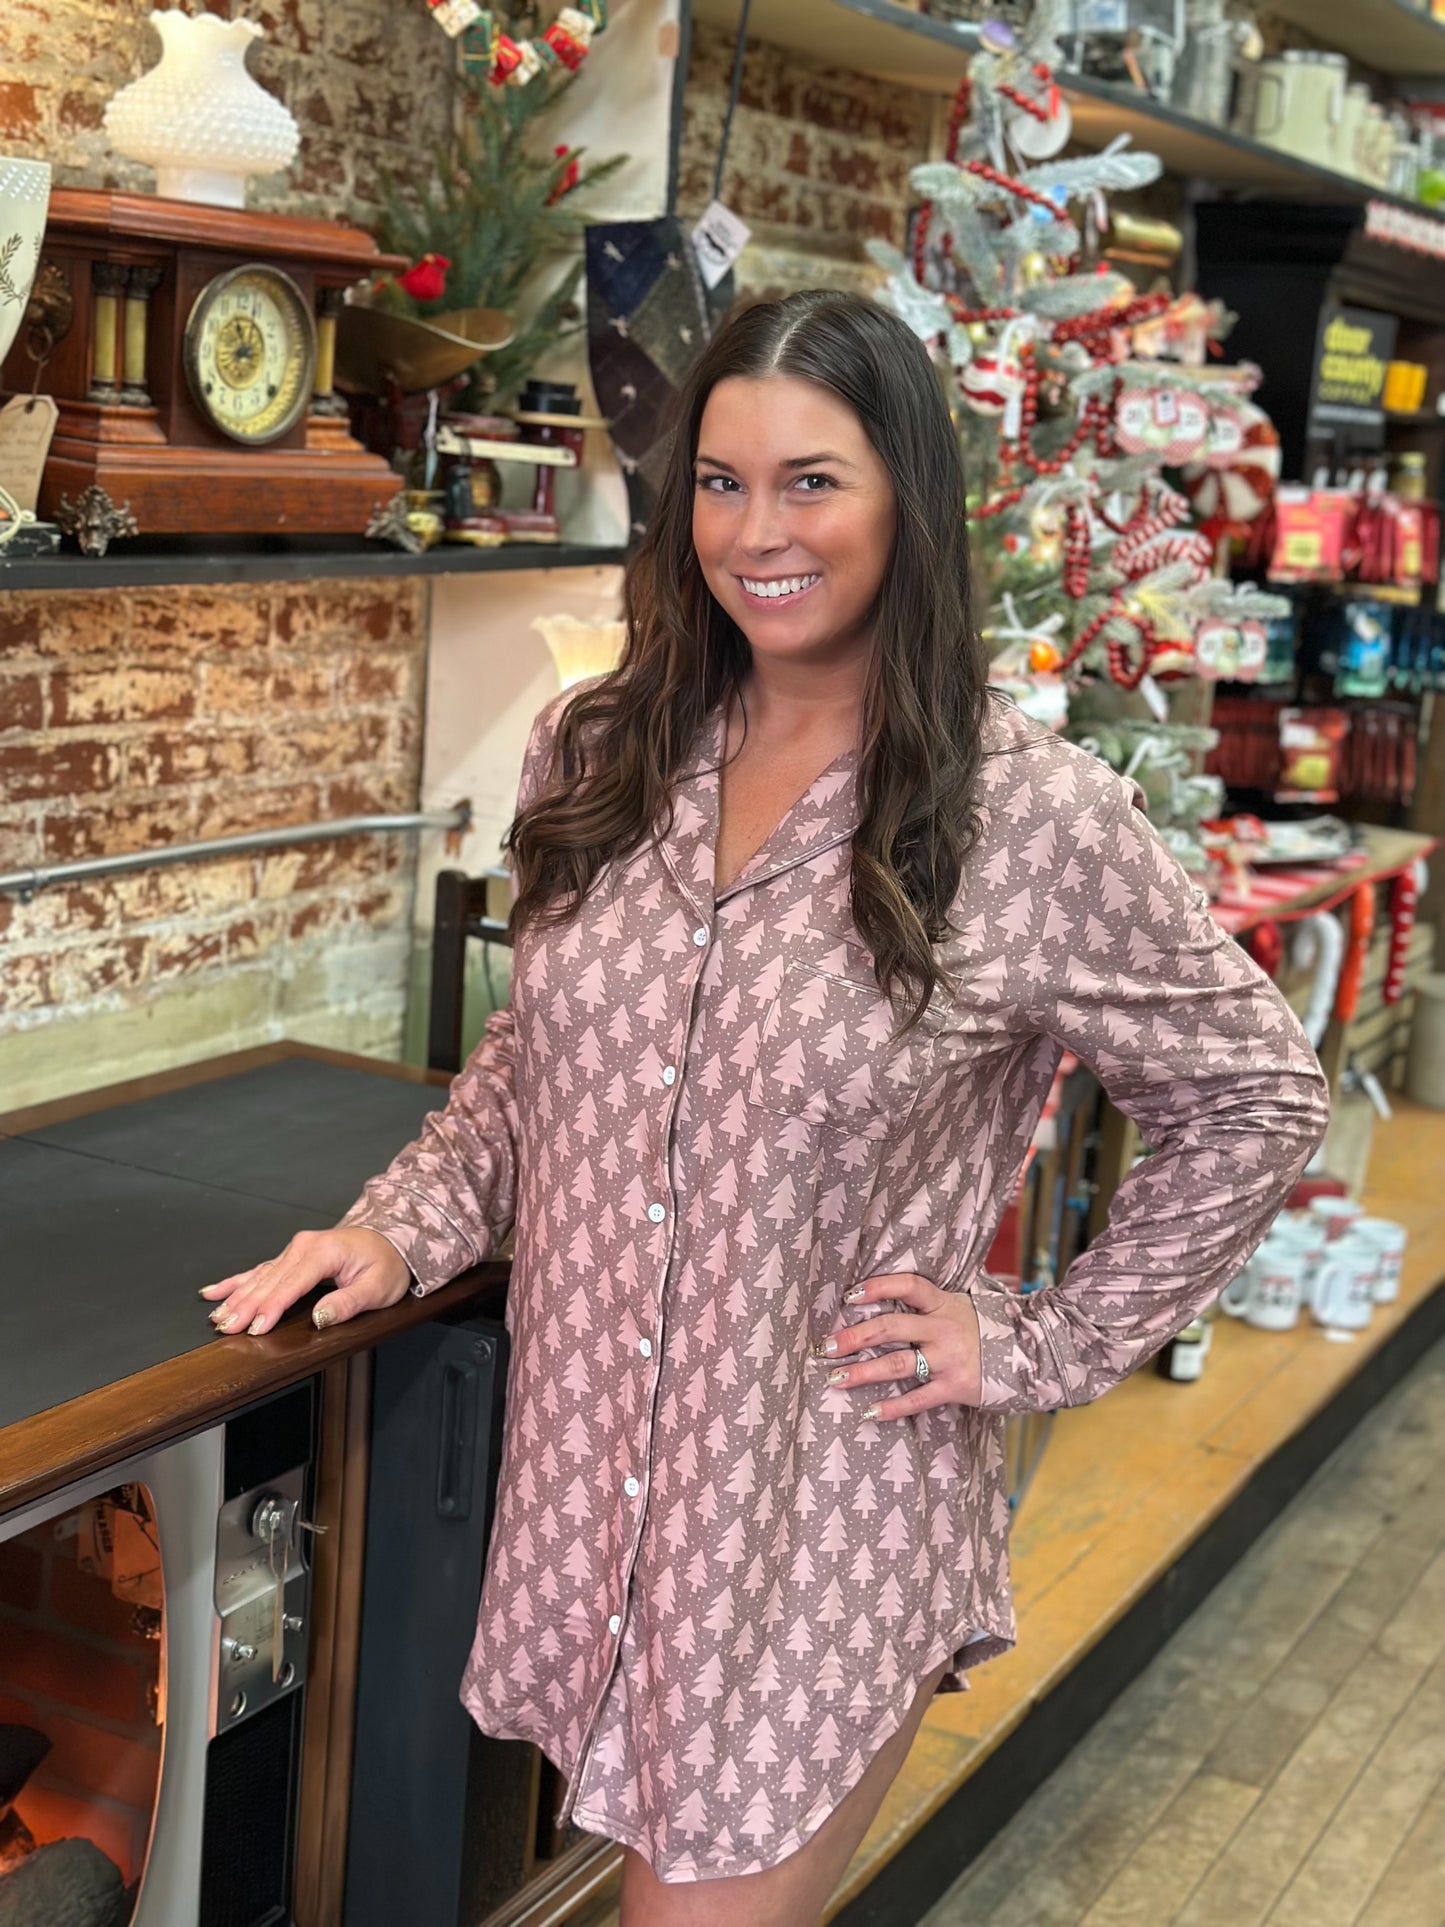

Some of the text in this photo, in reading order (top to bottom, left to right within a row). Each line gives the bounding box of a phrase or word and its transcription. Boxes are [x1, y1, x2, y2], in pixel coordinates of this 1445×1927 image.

[237, 293, 250, 310] 12
[219, 386, 227, 405] 7
[232, 395, 244, 412] 6
